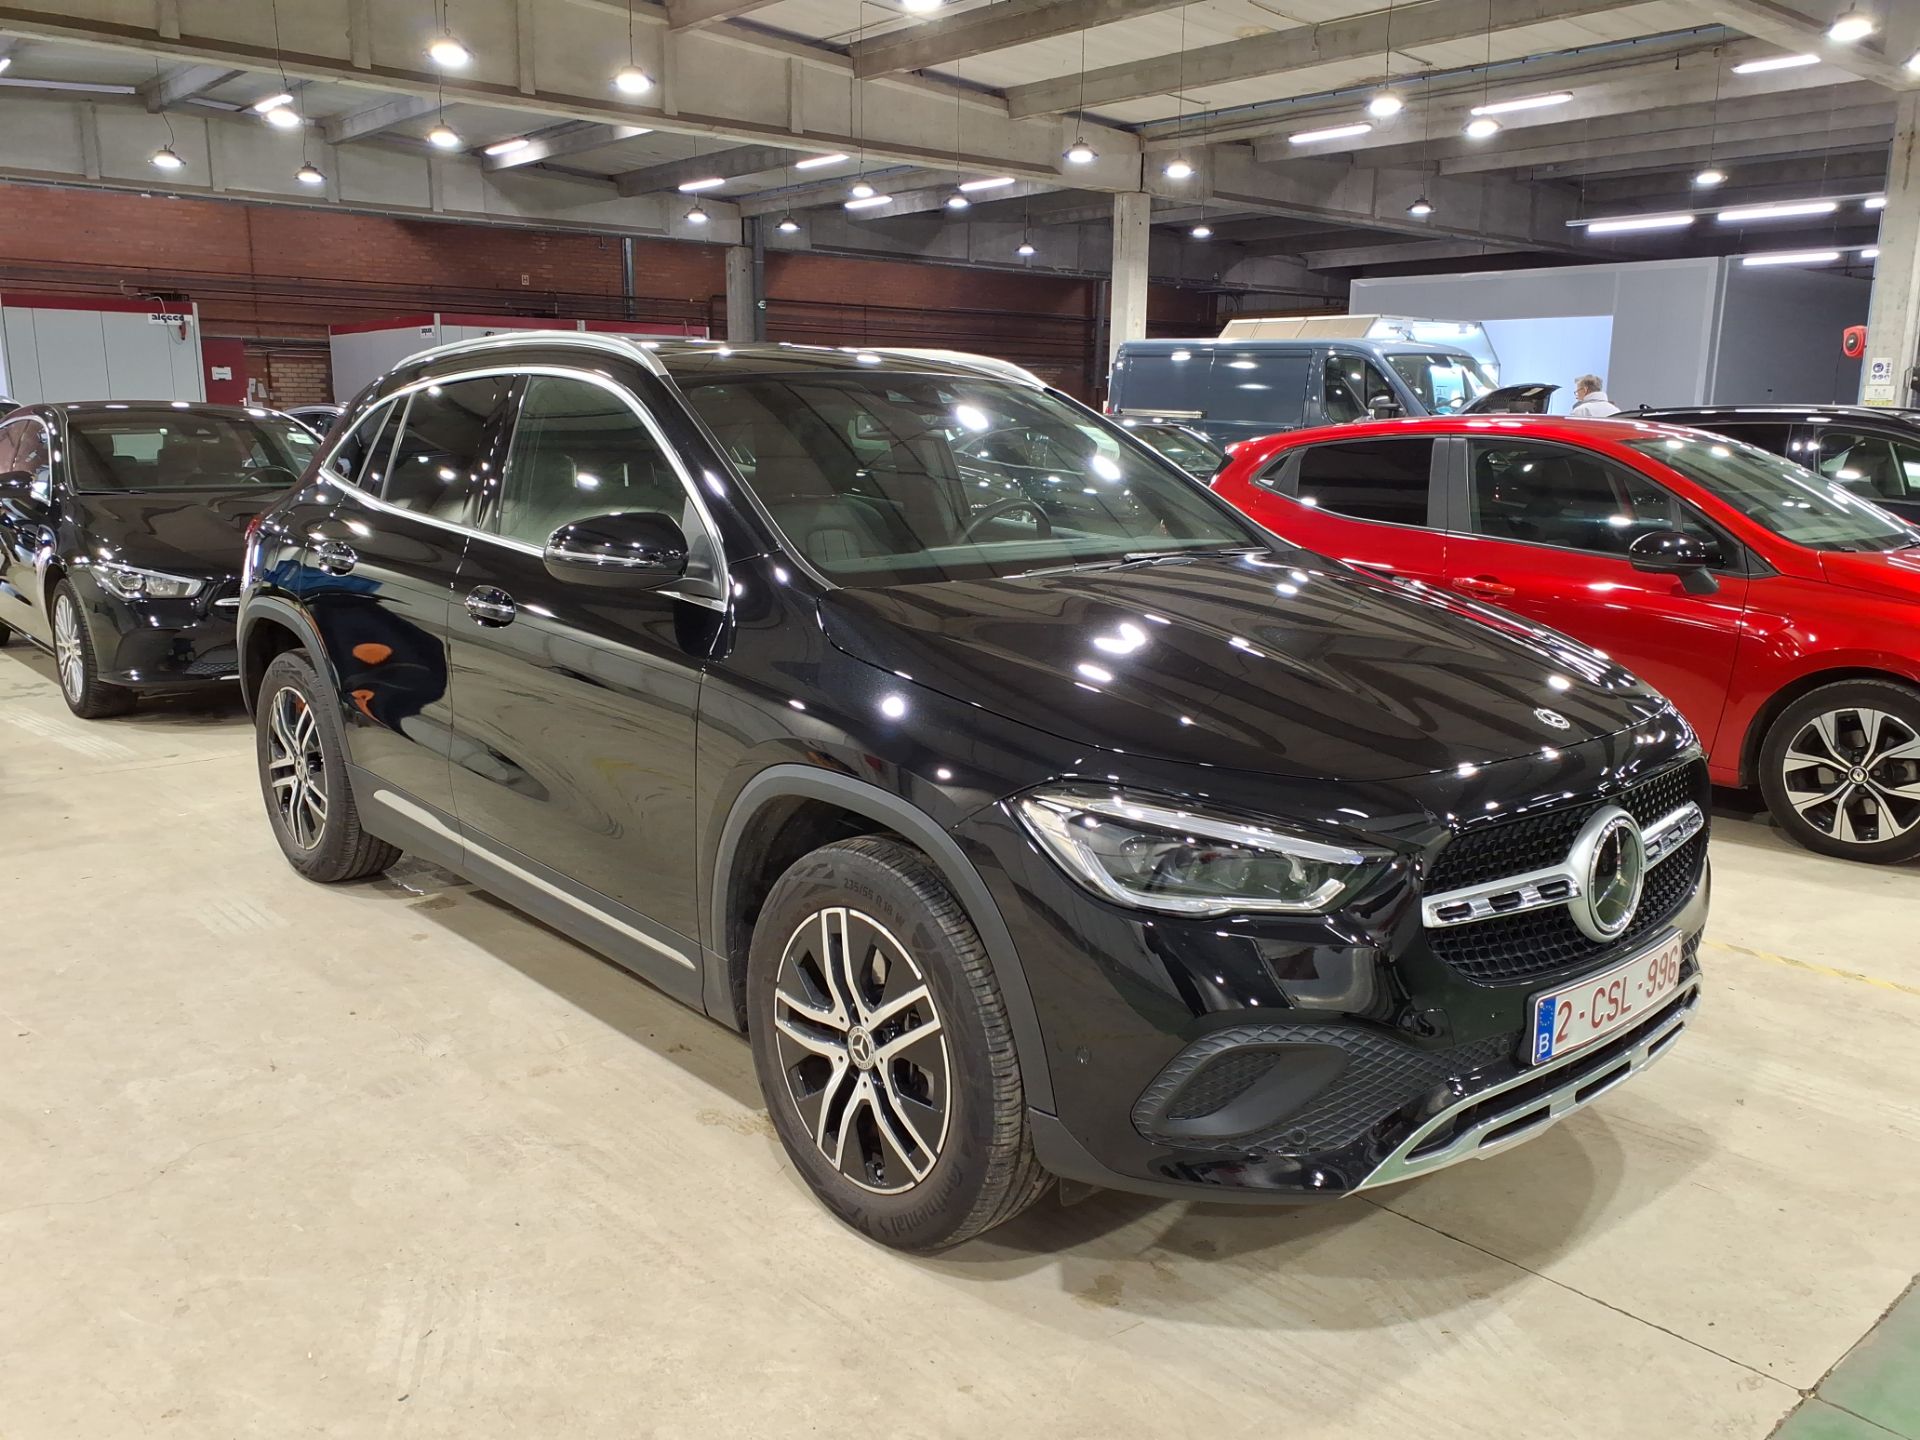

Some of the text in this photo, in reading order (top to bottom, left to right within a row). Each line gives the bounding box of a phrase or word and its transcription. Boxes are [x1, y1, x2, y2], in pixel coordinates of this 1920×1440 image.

[1555, 945, 1678, 1045] 2-CSL-996
[1539, 1032, 1550, 1054] B
[889, 1161, 964, 1237] Continental
